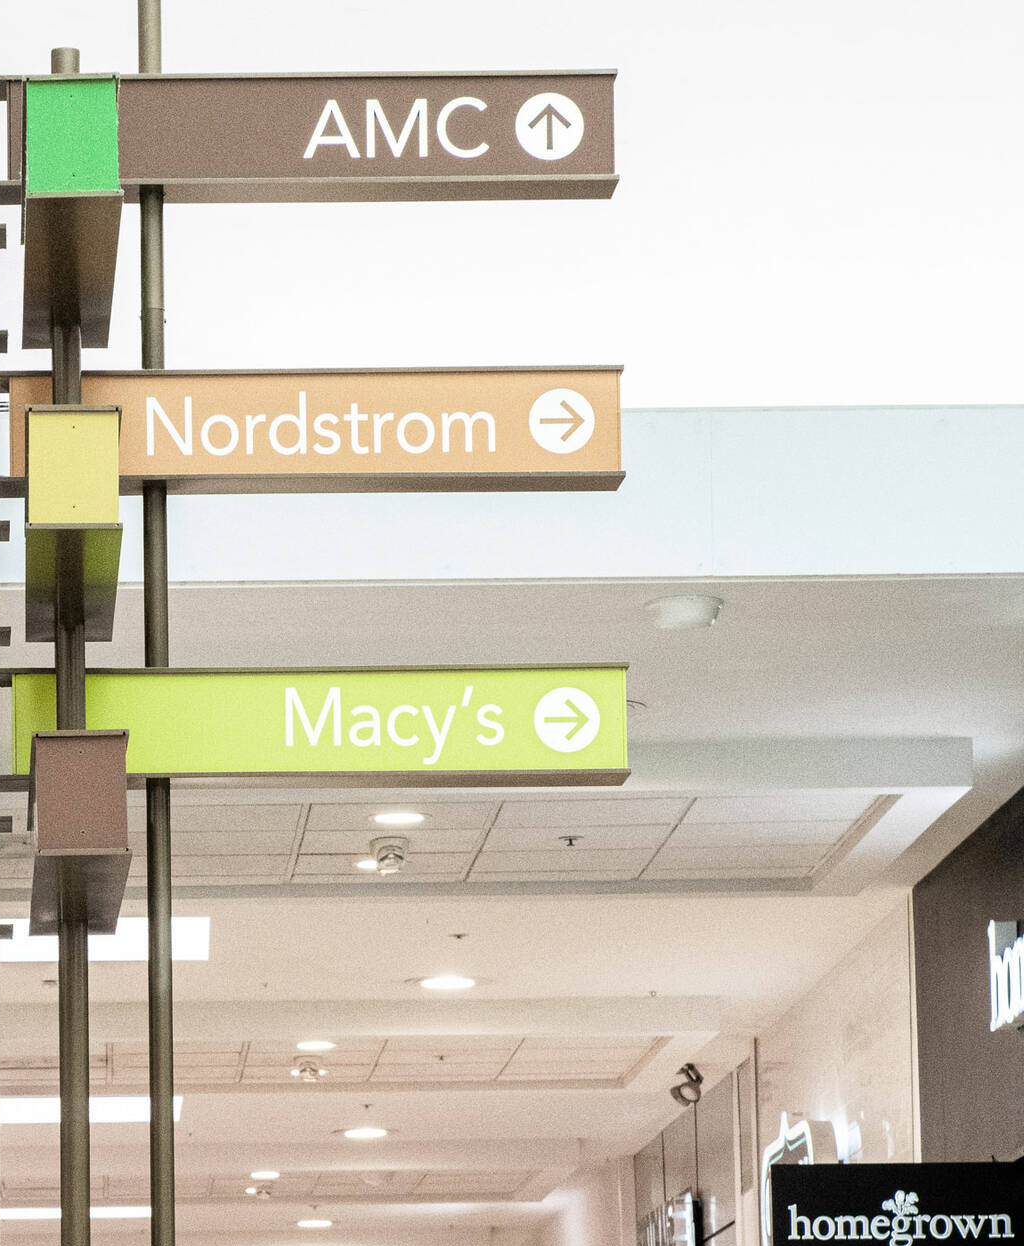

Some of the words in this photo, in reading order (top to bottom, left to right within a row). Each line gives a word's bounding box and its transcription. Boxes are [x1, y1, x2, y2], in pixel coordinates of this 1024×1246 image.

[303, 96, 490, 159] AMC
[145, 391, 497, 457] Nordstrom
[284, 685, 505, 765] Macy's
